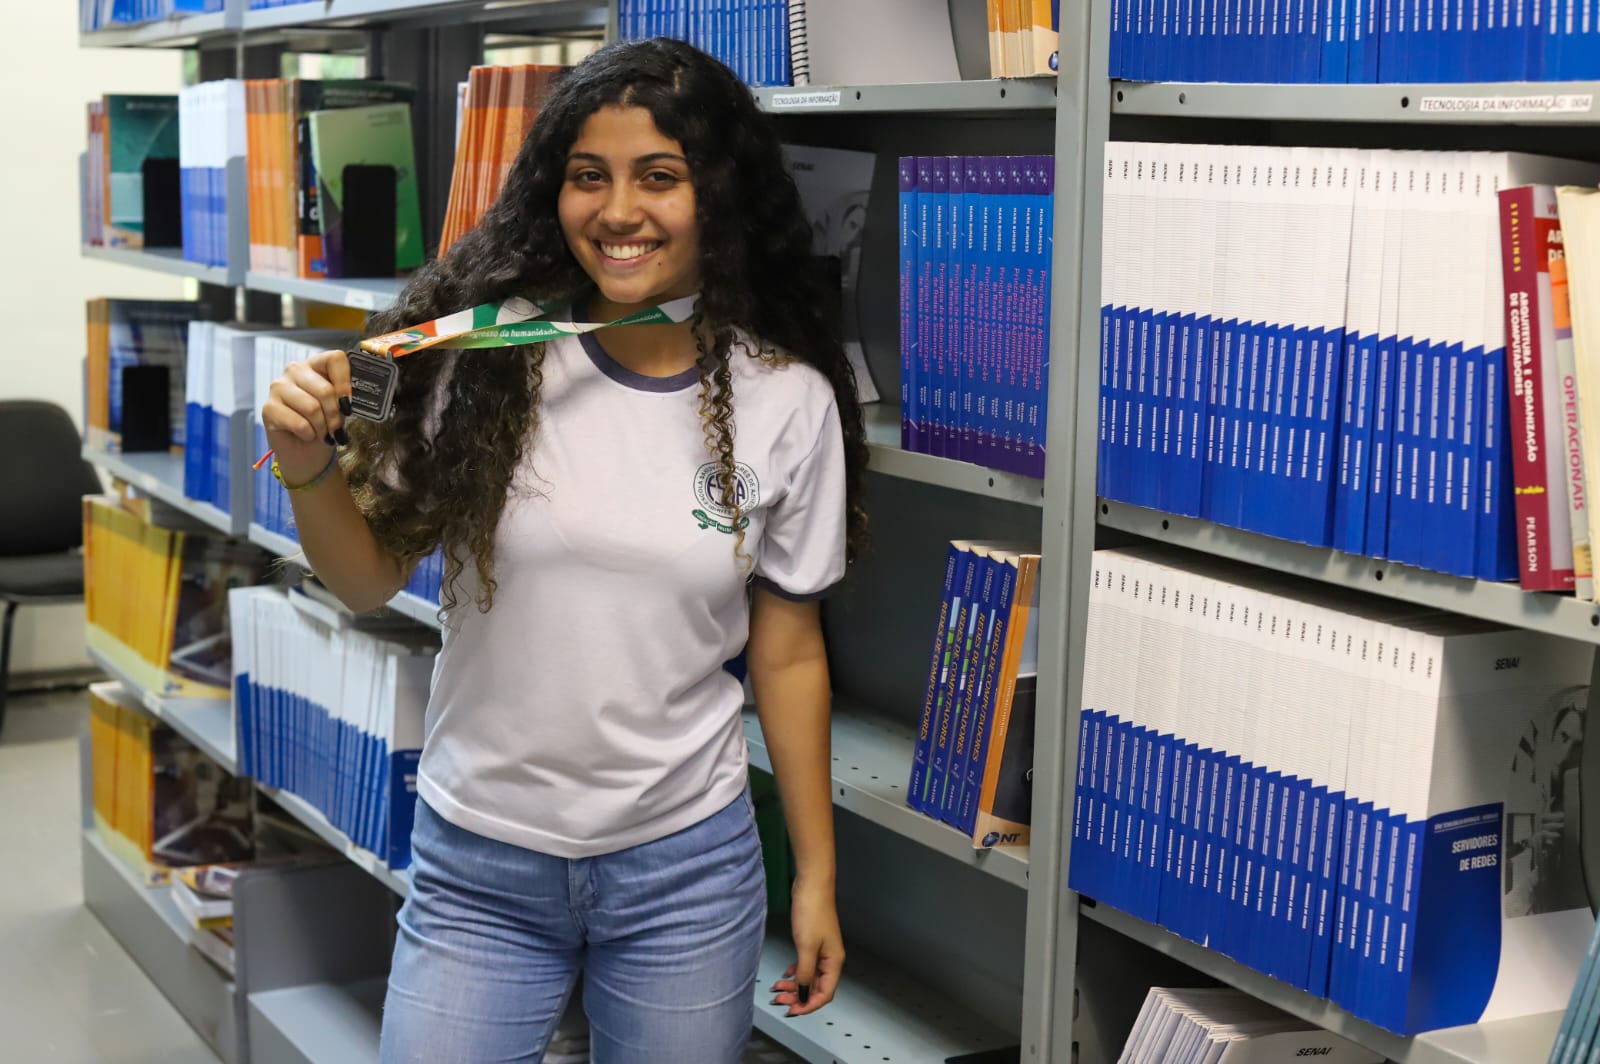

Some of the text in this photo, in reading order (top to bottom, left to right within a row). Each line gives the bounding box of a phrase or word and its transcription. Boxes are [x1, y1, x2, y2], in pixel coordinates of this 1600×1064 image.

[1423, 100, 1479, 110] TECNOLOGIA
[1482, 100, 1495, 110] DA
[1500, 97, 1564, 110] INFORMAÇÃO
[1510, 203, 1521, 272] STALLINGS
[992, 282, 997, 292] de
[1007, 283, 1012, 292] de
[1020, 284, 1025, 293] de
[1033, 286, 1038, 295] de
[998, 311, 1003, 320] de
[1012, 312, 1018, 322] de
[1025, 314, 1031, 323] de
[1038, 316, 1043, 325] de
[500, 329, 509, 337] da
[1519, 291, 1532, 365] ARQUITETURA
[1510, 292, 1523, 396] DE COMPUTADORES
[1022, 327, 1030, 388] Administração
[1035, 329, 1043, 390] Administração
[1524, 379, 1537, 462] ORGANIZAÇÃO
[1563, 375, 1585, 511] OPERACIONAIS
[1526, 517, 1538, 572] PEARSON
[921, 601, 948, 741] REDES DE COMPUTADORES
[939, 607, 967, 749] REDES DE COMPUTADORES
[956, 613, 985, 755] REDES DE COMPUTADORES
[972, 619, 1002, 762] REDES DE COMPUTADORES
[1001, 833, 1020, 842] NT
[1452, 834, 1498, 854] SERVIDORES
[1459, 854, 1497, 871] DE REDES
[1296, 1047, 1332, 1056] SENAI
